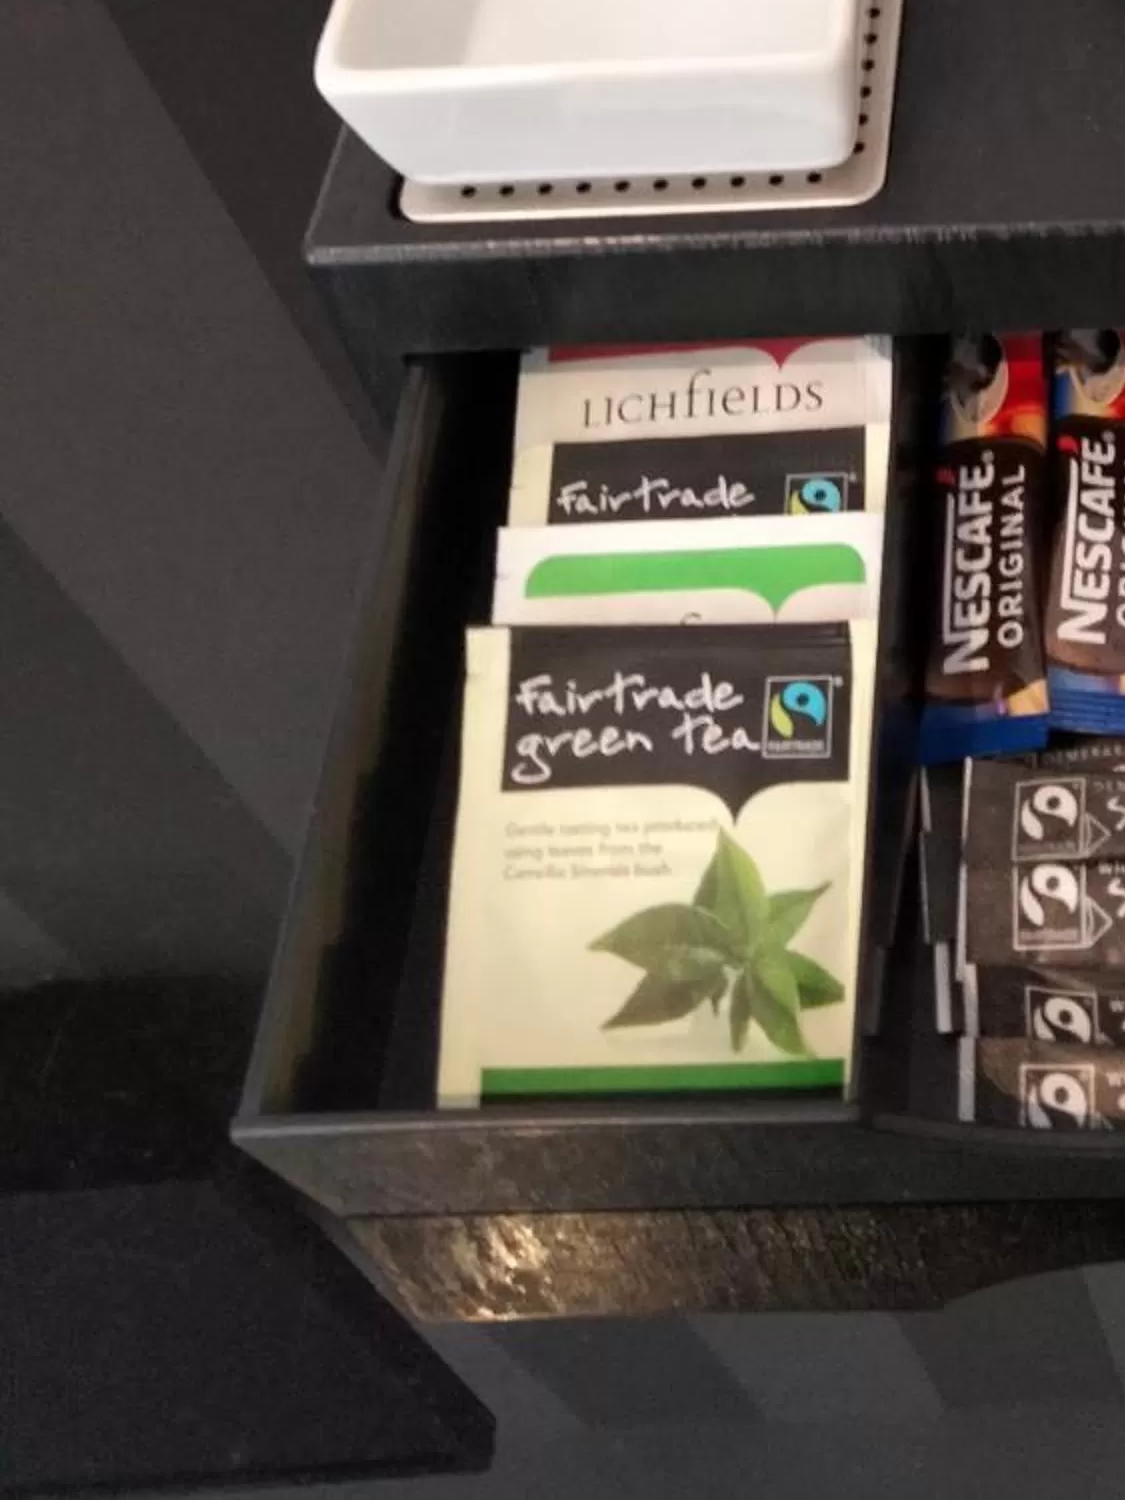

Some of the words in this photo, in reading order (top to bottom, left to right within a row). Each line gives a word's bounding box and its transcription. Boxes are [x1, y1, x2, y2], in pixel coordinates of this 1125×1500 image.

[555, 475, 757, 517] Fairtrade
[996, 463, 1027, 649] ORIGINAL
[515, 671, 746, 717] Fairtrade
[510, 728, 654, 784] green
[670, 713, 762, 757] tea
